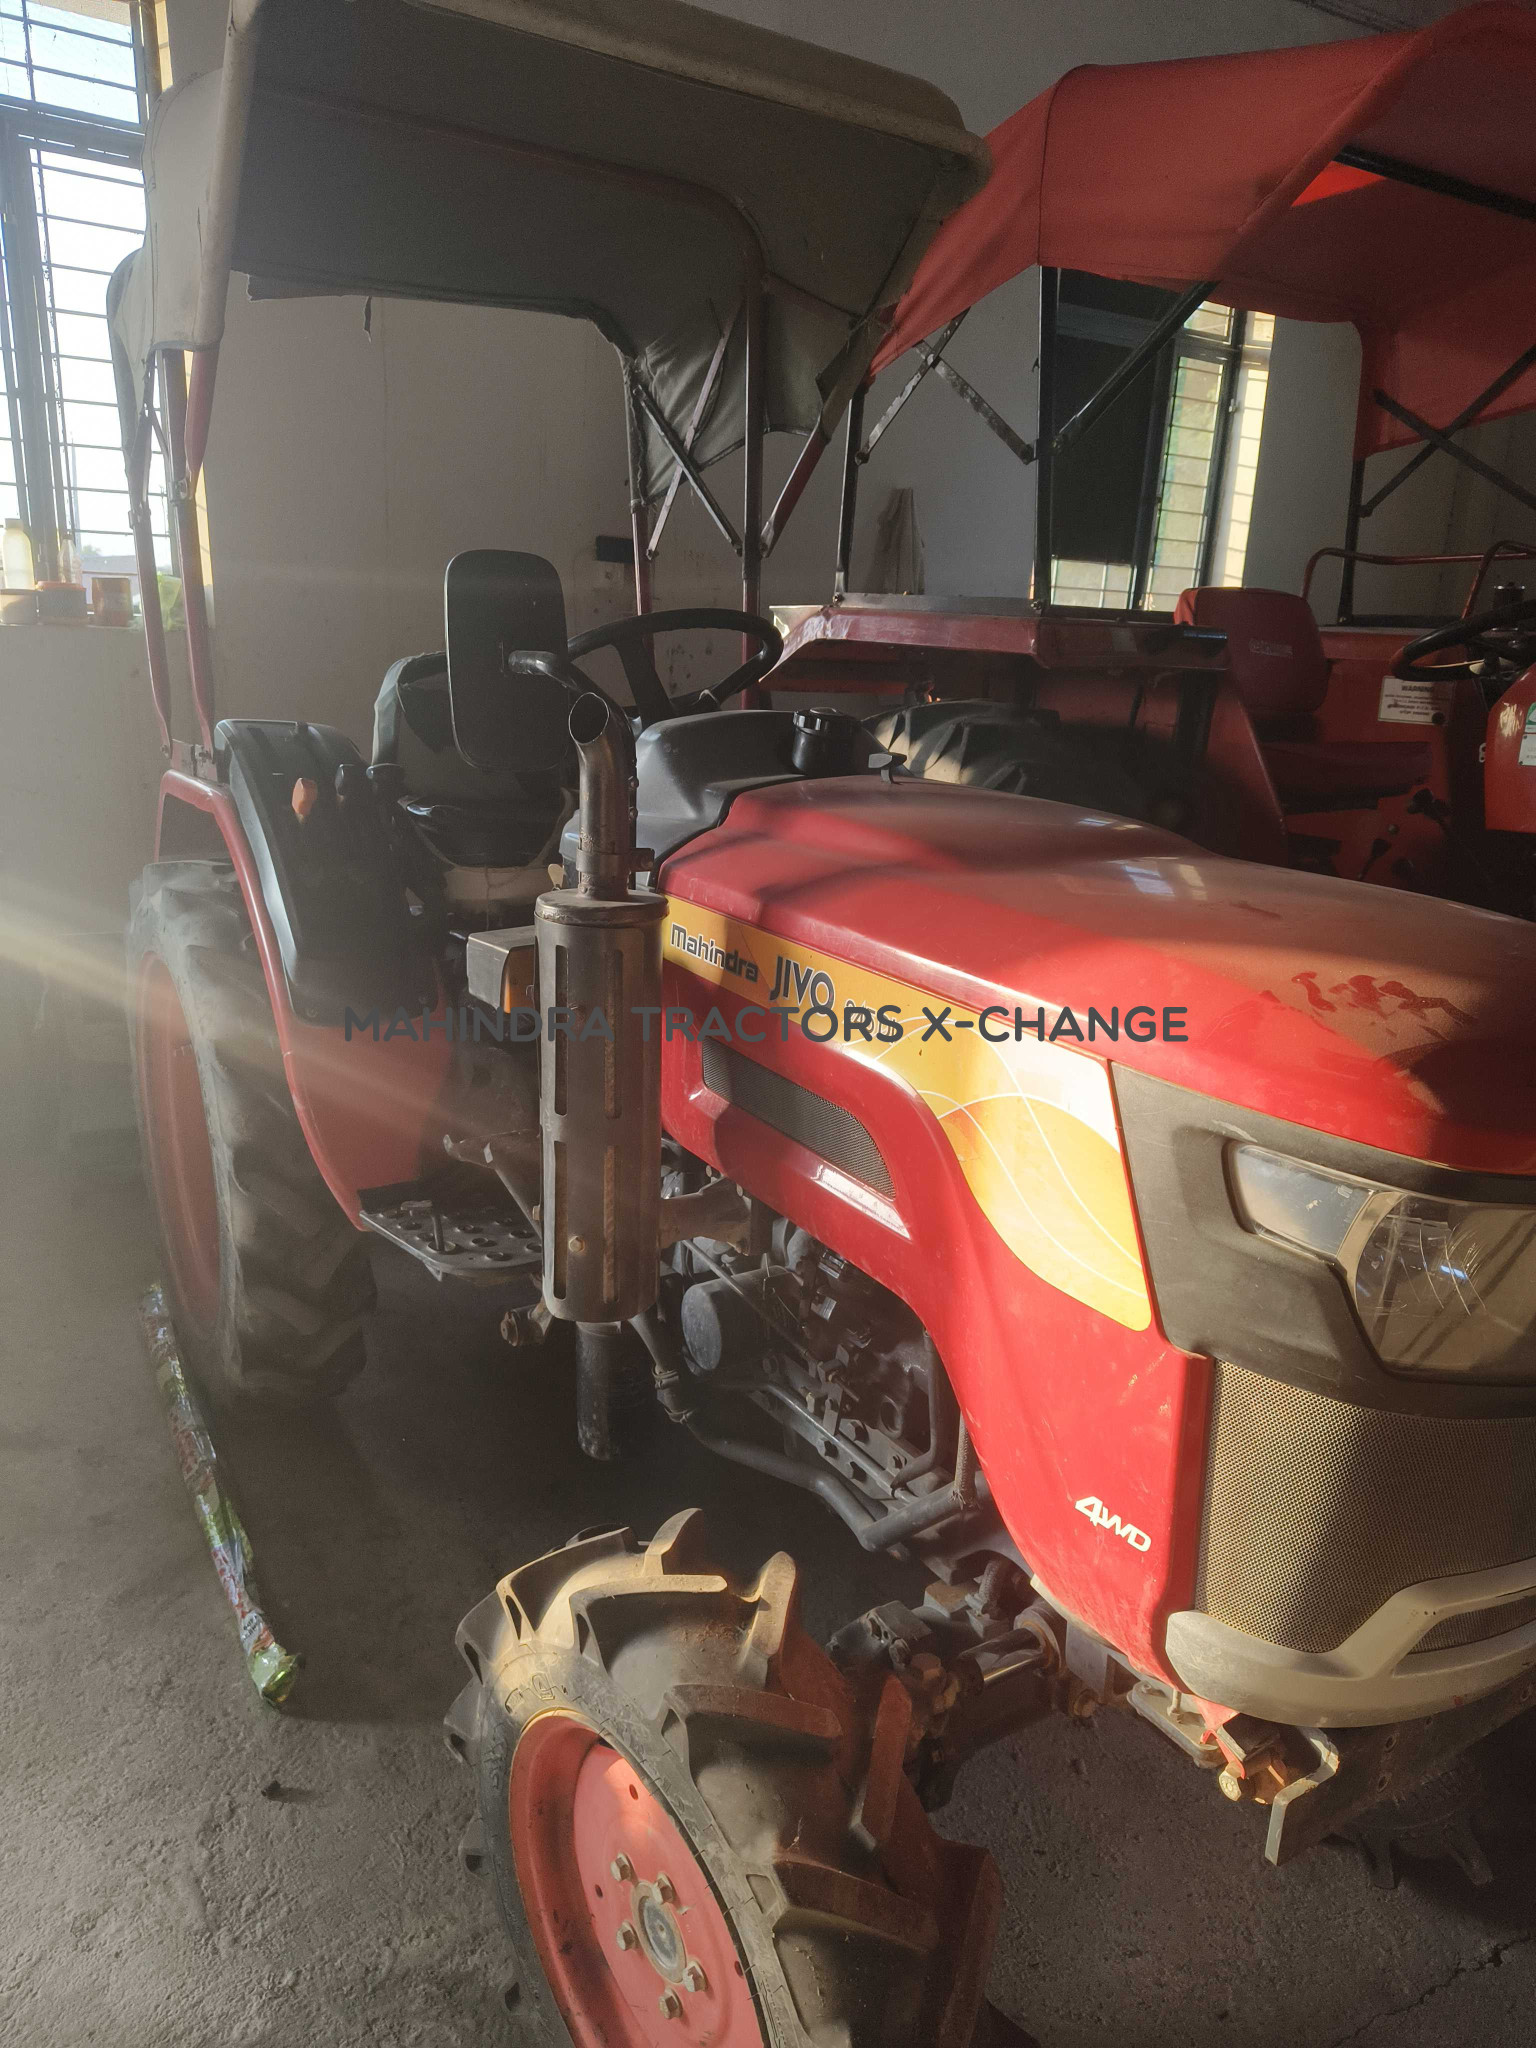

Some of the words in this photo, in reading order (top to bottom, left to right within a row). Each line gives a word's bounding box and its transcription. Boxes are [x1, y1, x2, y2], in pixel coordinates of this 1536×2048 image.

[671, 923, 758, 983] Mahindra
[769, 955, 835, 1016] JIVO
[1074, 1496, 1152, 1552] 4WD
